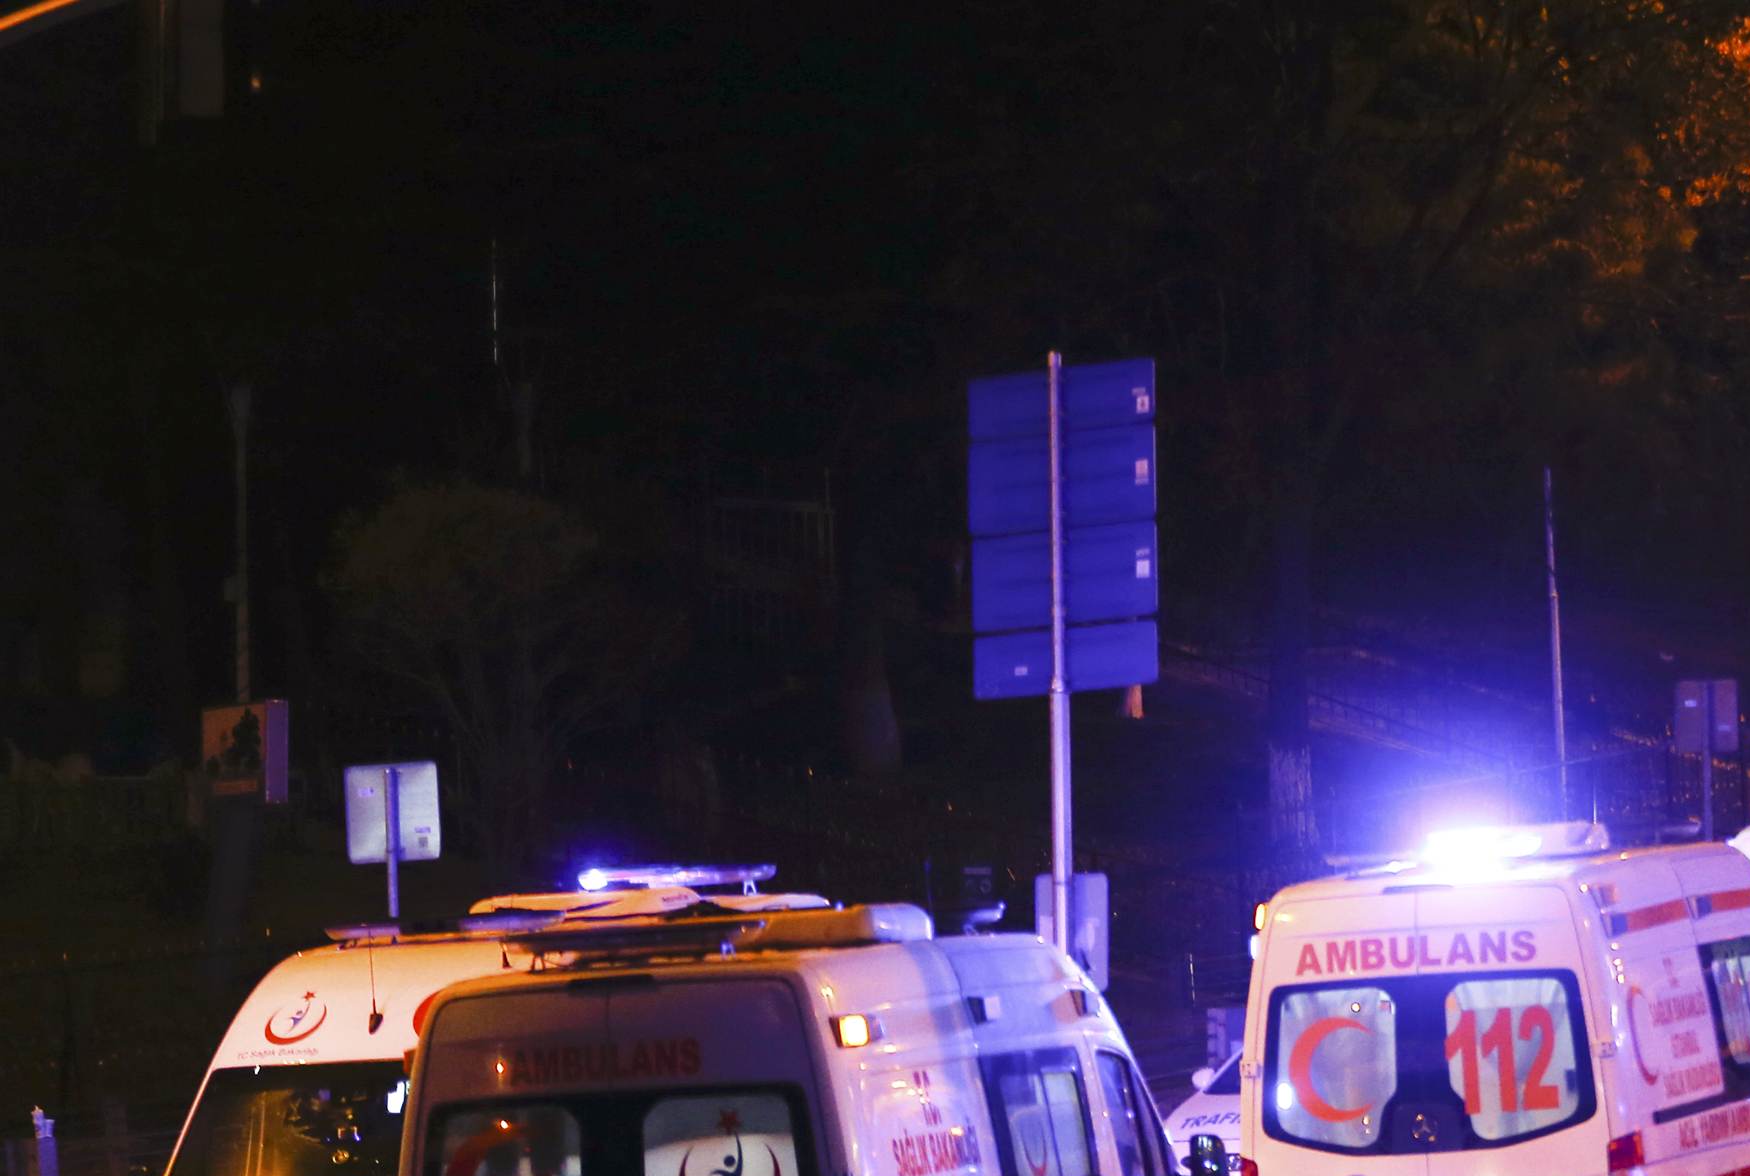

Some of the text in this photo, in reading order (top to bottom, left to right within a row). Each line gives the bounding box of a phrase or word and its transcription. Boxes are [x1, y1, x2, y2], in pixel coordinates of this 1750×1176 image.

[1297, 930, 1536, 976] AMBULANS
[510, 1039, 699, 1086] AMBULANS
[1445, 1005, 1559, 1116] 112
